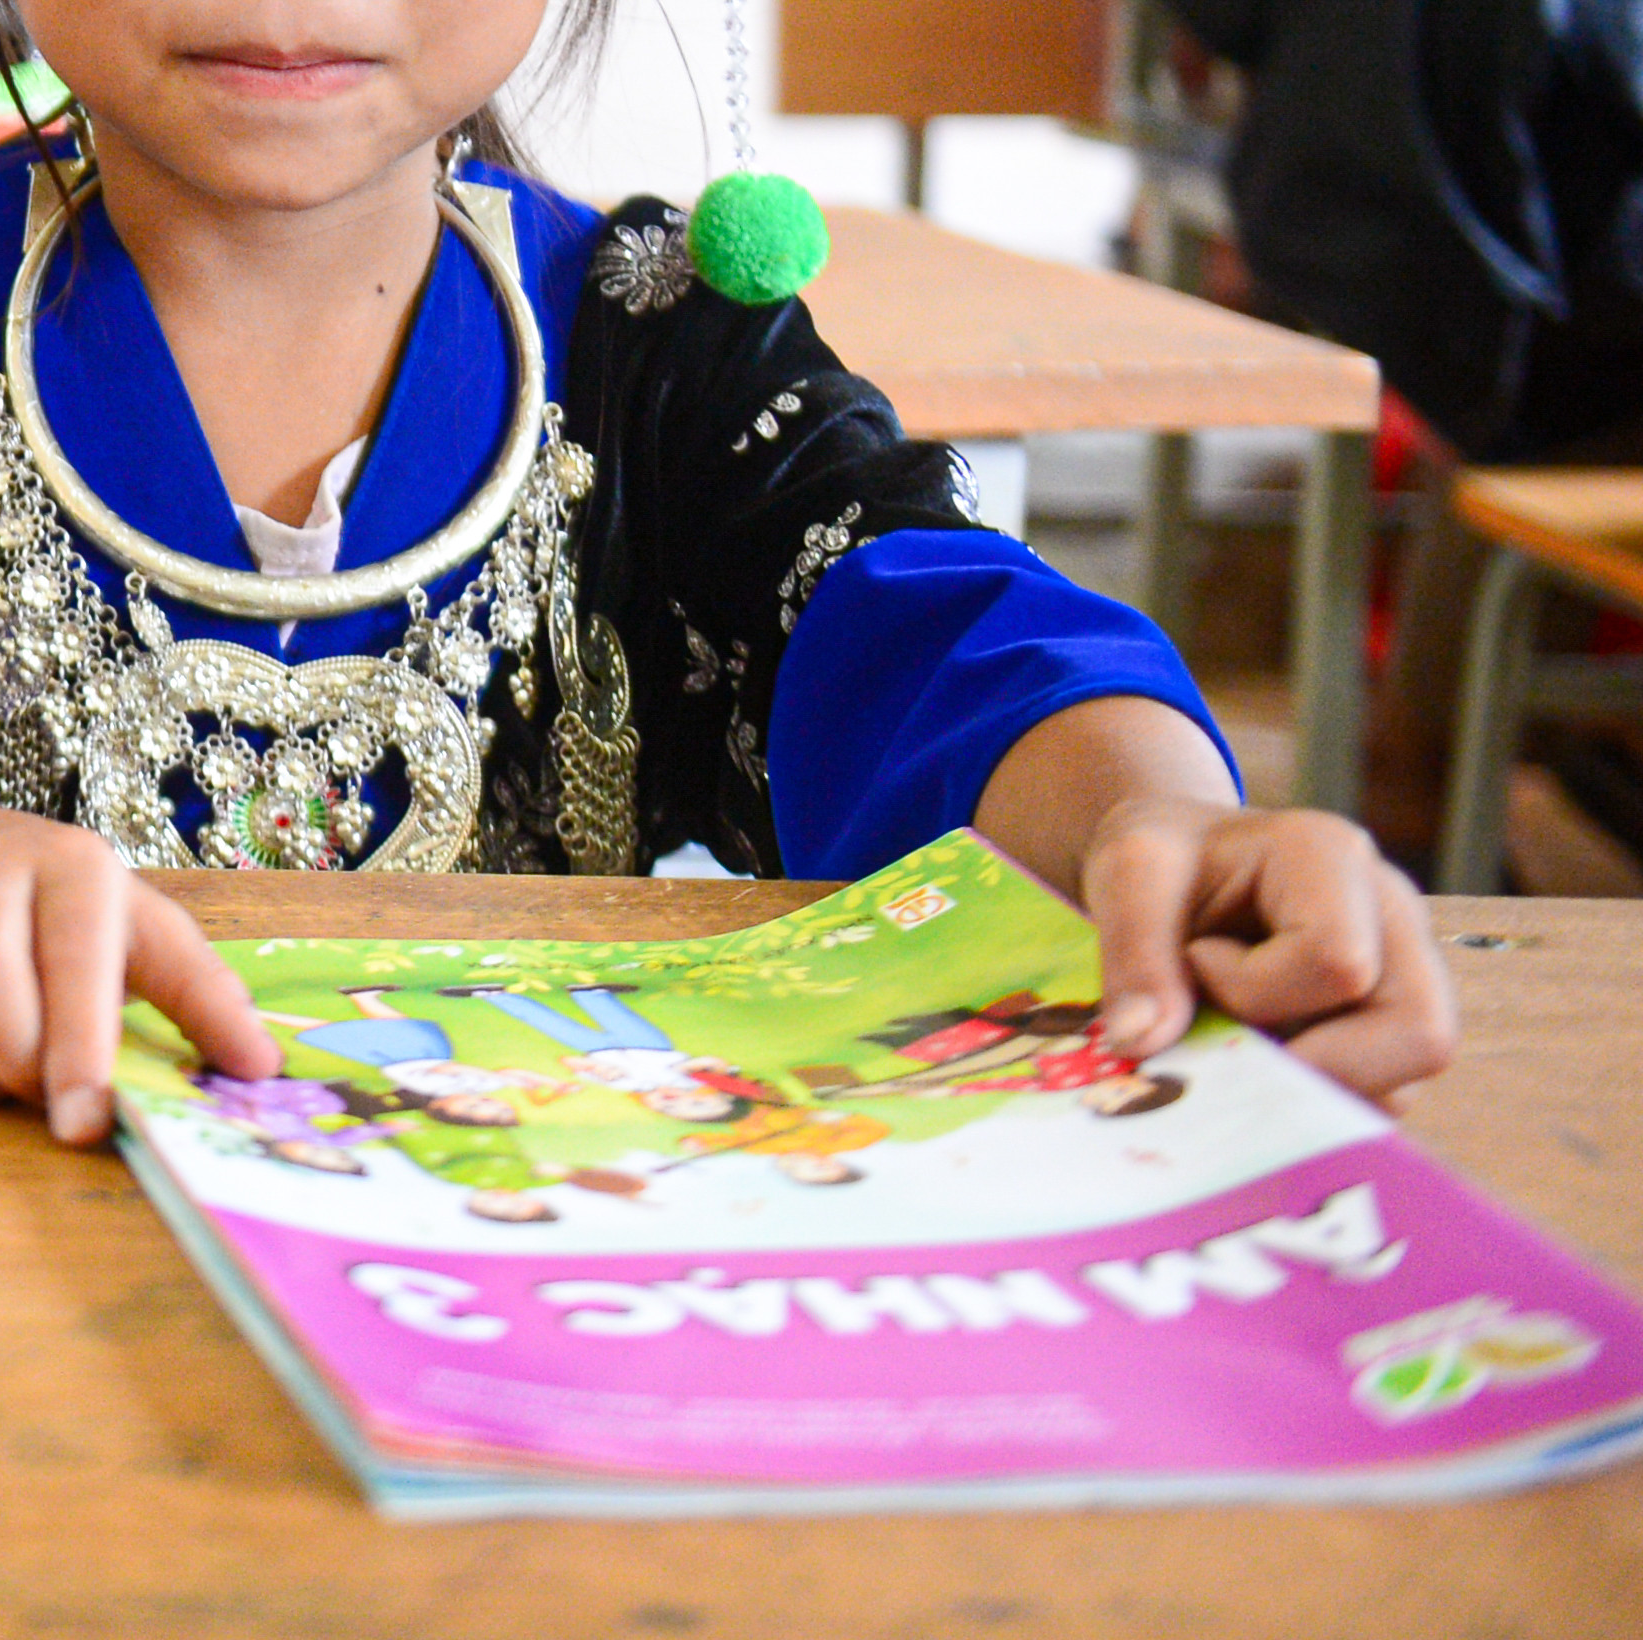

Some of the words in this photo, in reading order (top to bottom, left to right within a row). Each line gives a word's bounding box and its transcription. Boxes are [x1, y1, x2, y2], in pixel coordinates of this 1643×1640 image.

[1083, 1180, 1408, 1323] ÂM
[345, 1260, 510, 1344] 3
[534, 1264, 1095, 1336] NHẠC
